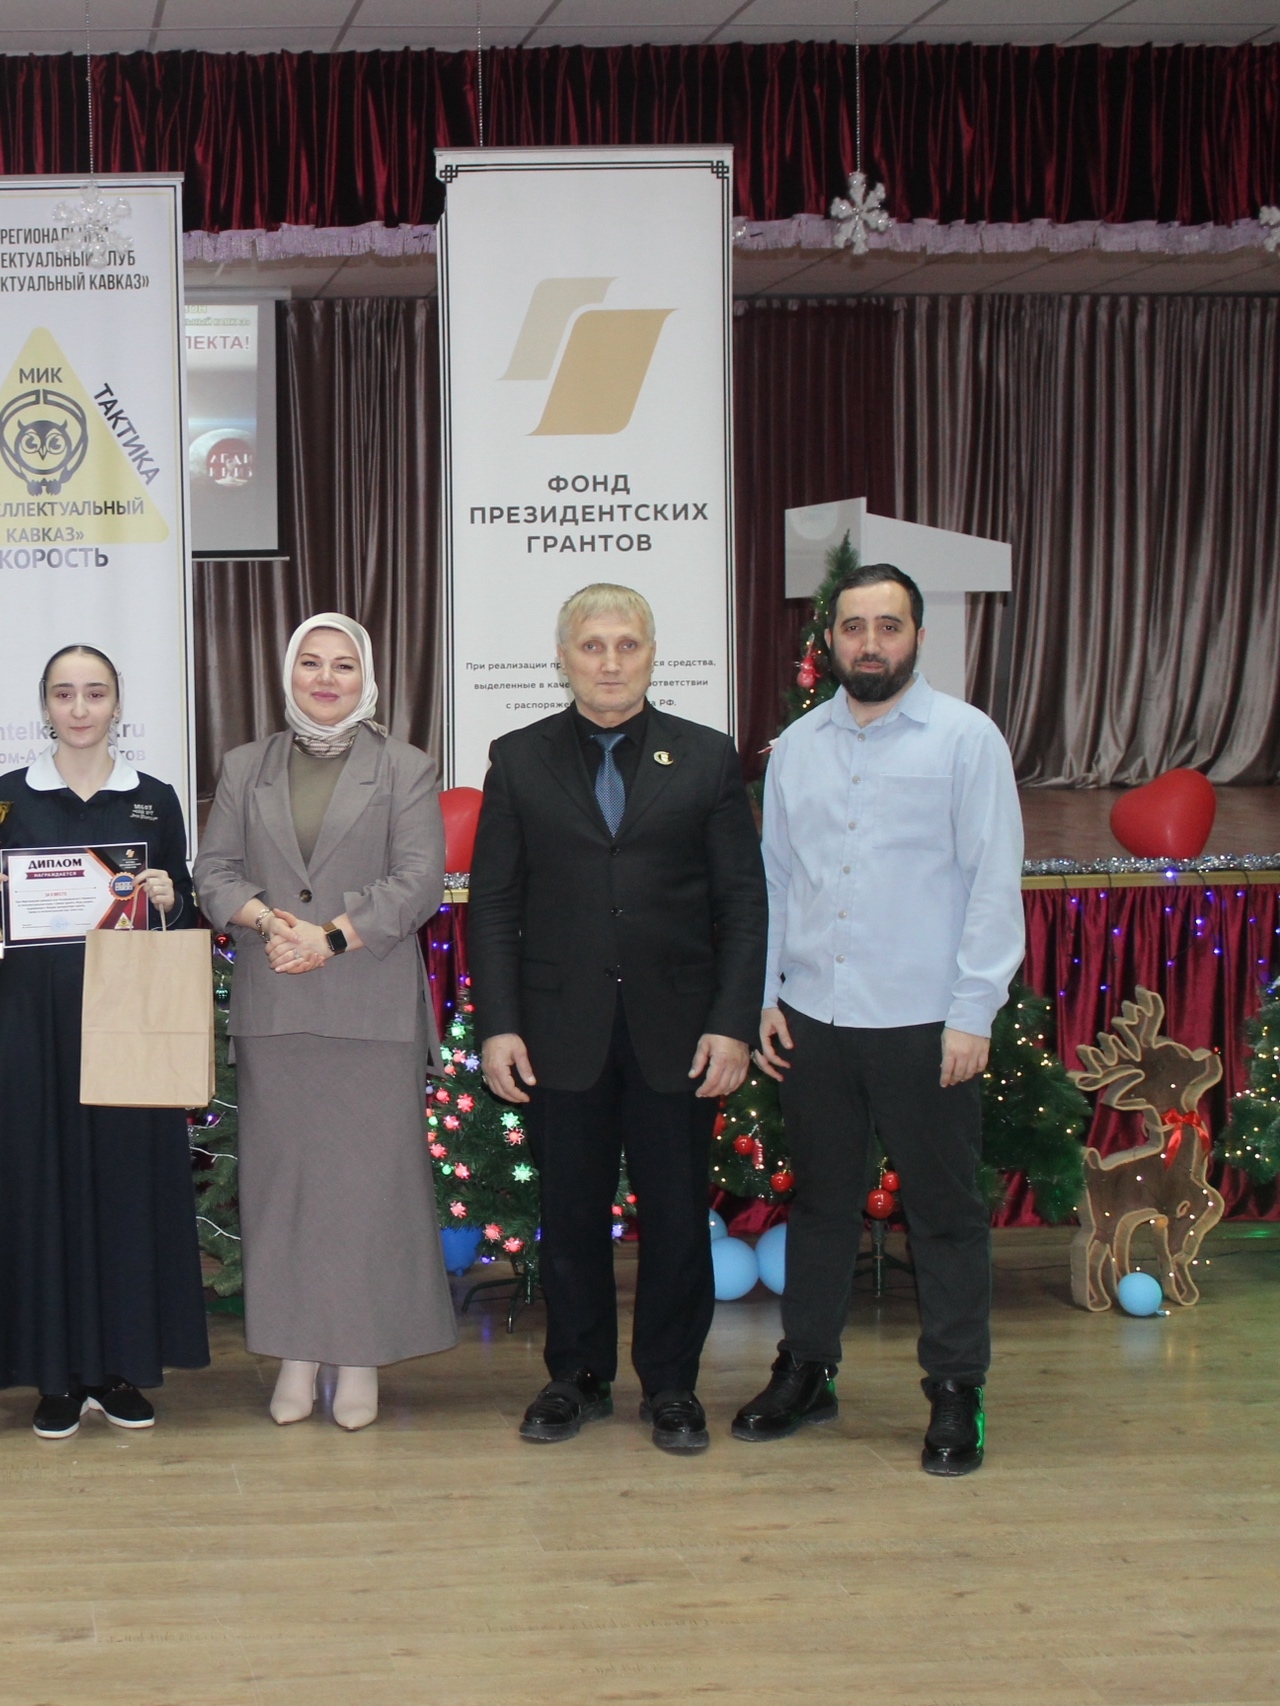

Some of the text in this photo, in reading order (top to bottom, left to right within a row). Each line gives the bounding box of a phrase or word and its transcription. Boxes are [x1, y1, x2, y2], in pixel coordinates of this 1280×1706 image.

[89, 273, 150, 290] КАВКАЗ»
[19, 367, 63, 384] МИК
[93, 382, 161, 485] ТАКТИКА
[547, 474, 631, 495] ФОНД
[470, 503, 709, 525] ПРЕЗИДЕНТСКИХ
[6, 527, 84, 543] КАВКАЗ»
[527, 534, 652, 553] ГРАНТОВ
[465, 662, 485, 671] При
[488, 662, 547, 671] реализации
[474, 682, 536, 690] выделенные
[514, 702, 571, 711] распоряже
[28, 858, 82, 870] ДИПЛОМ
